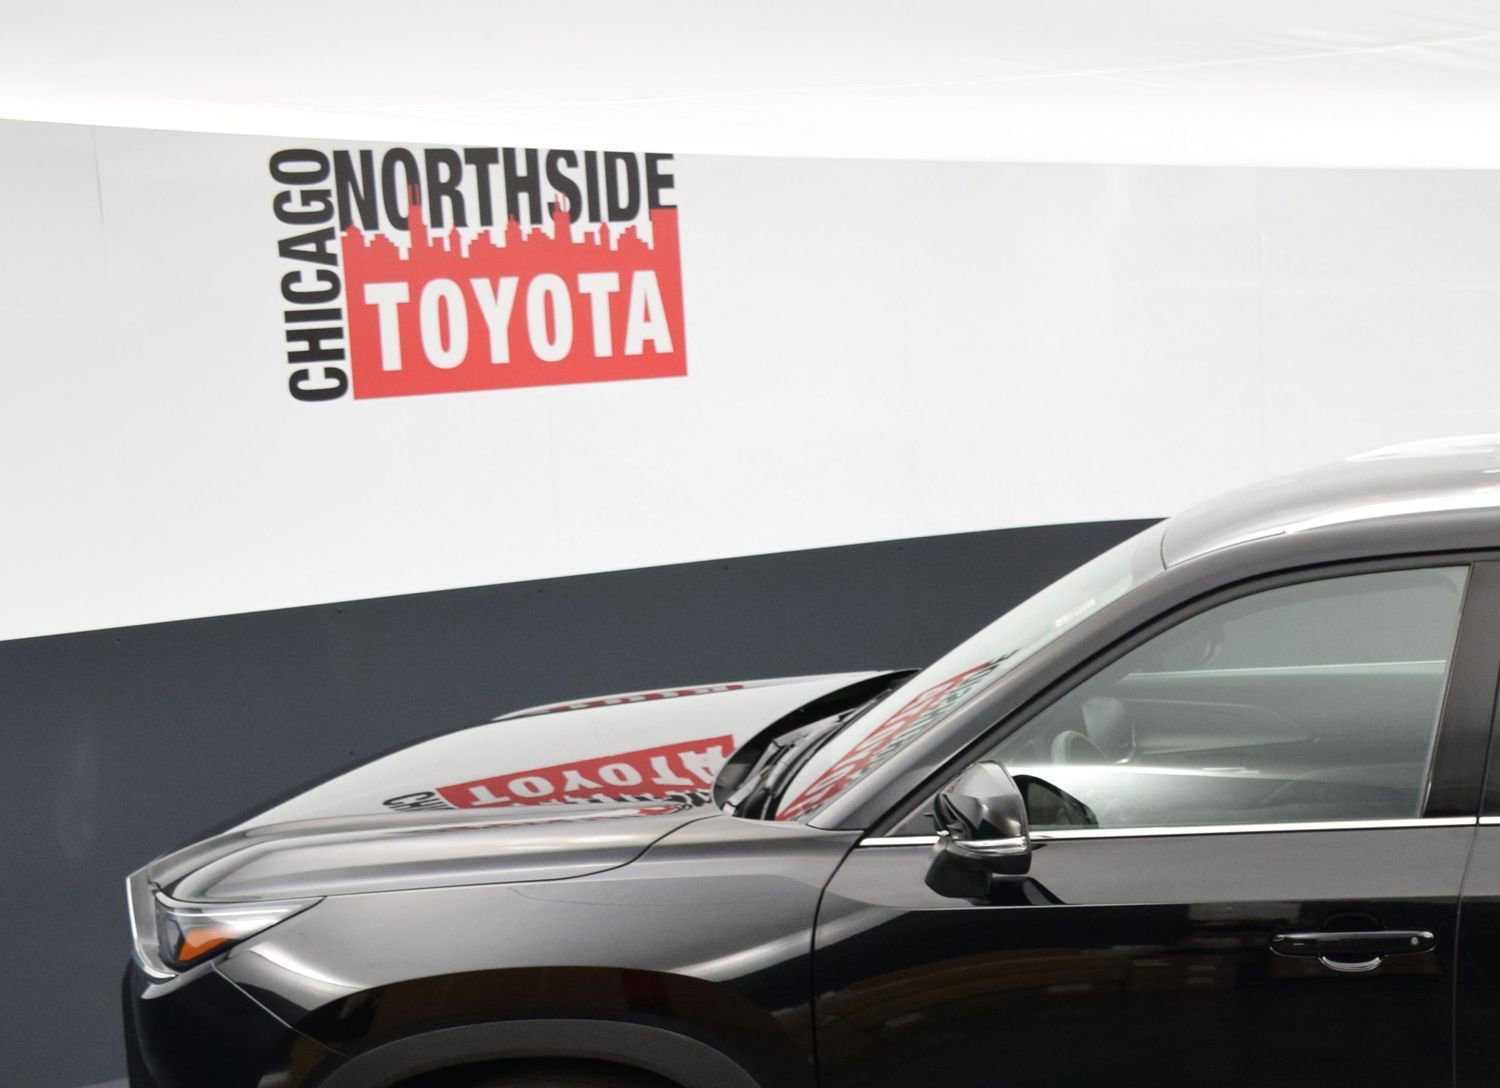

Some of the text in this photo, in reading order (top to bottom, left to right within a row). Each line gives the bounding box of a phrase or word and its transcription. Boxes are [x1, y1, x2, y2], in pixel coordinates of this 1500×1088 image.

[332, 147, 678, 232] NORTHSIDE
[269, 148, 349, 402] CHICAGO
[363, 270, 674, 371] TOYOTA
